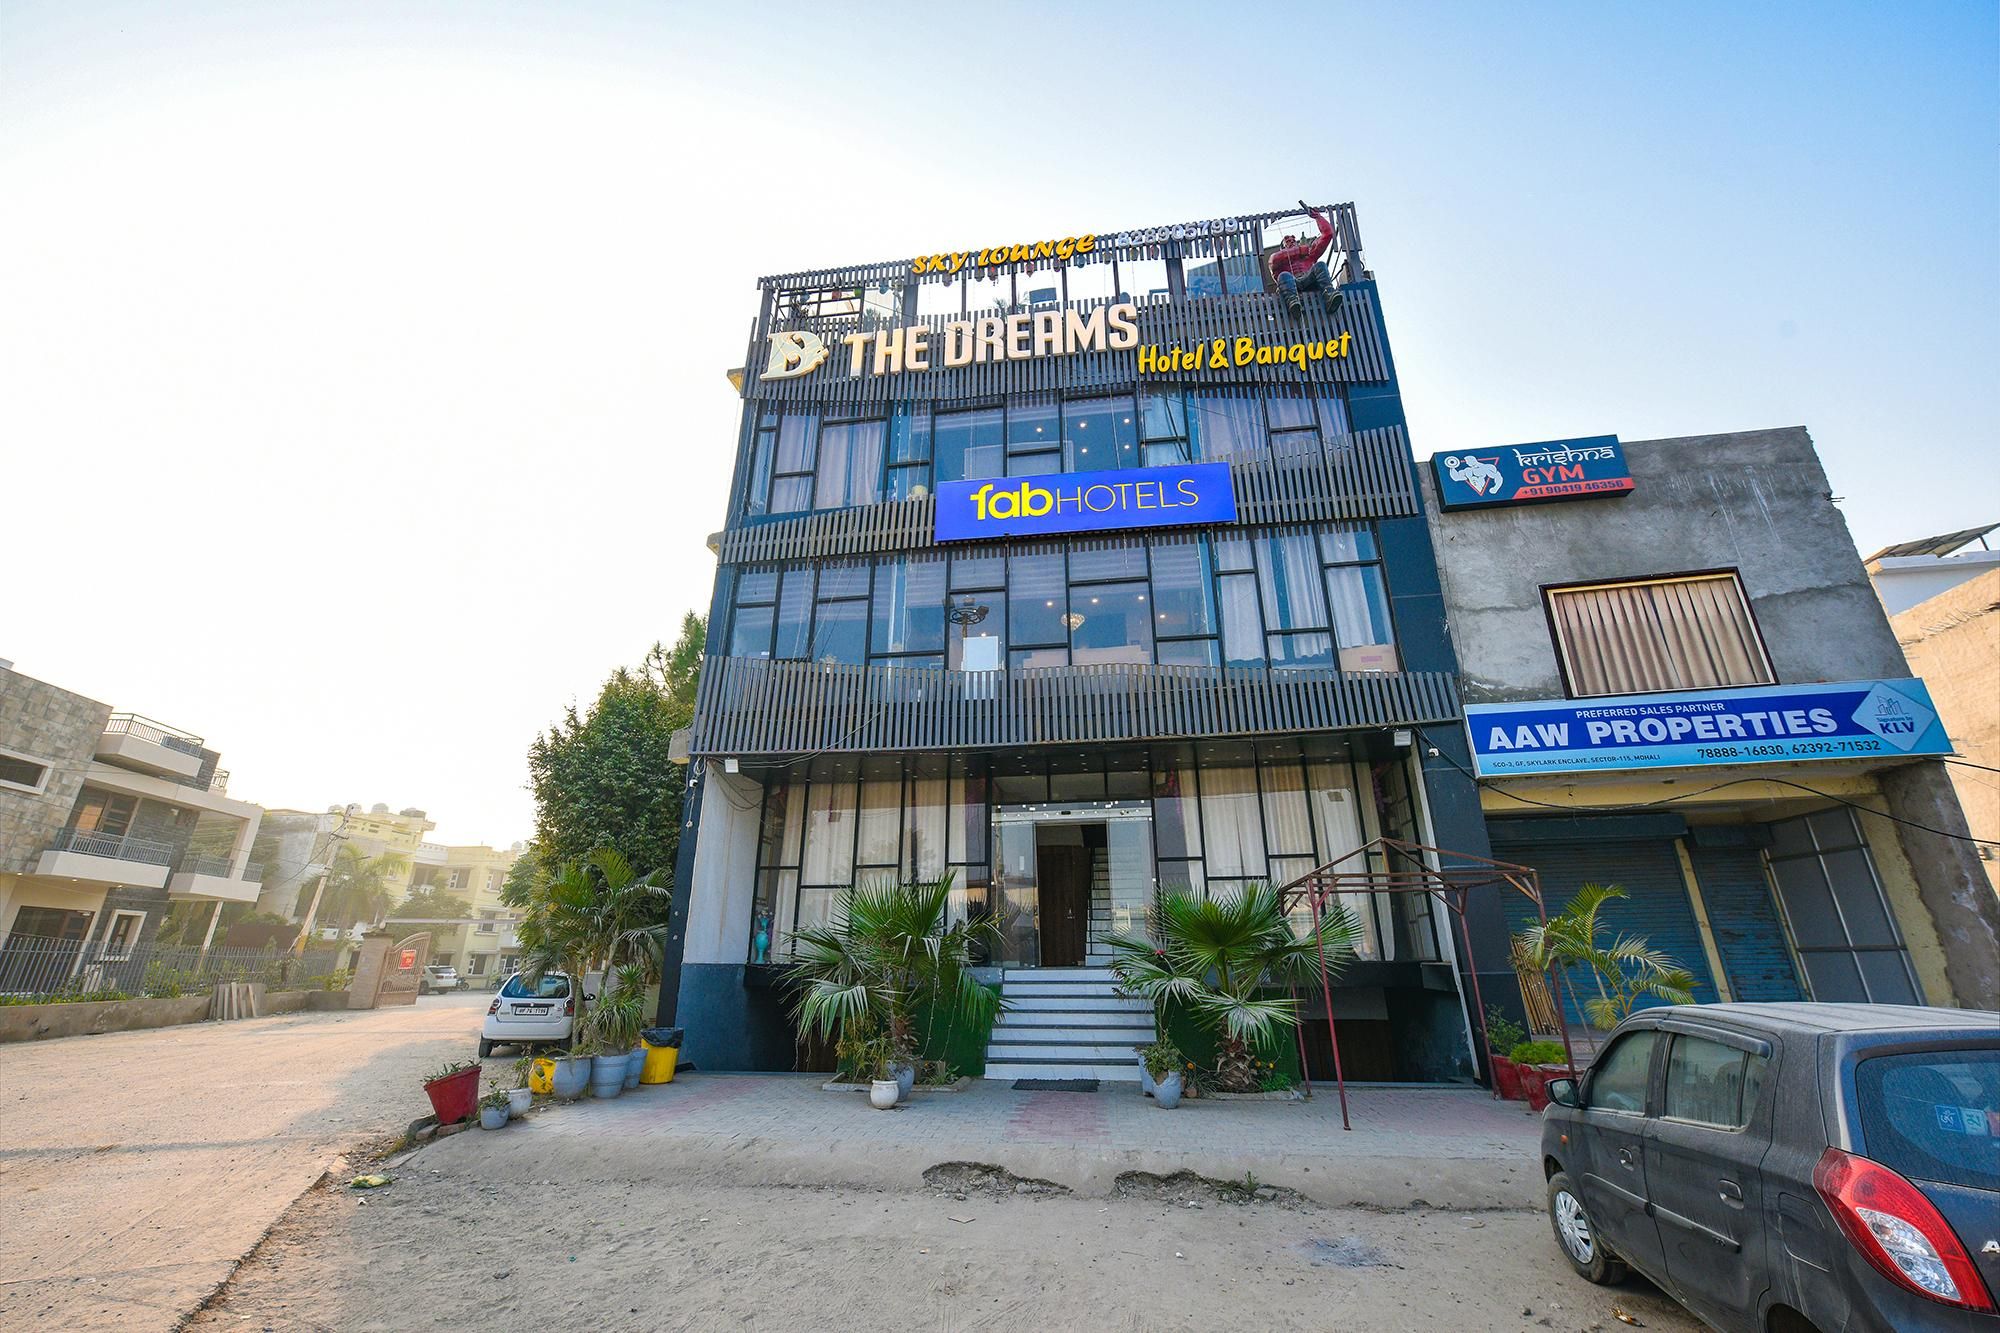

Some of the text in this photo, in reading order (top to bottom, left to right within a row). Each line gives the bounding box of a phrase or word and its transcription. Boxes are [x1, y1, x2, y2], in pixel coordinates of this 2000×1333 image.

[911, 233, 1095, 274] SKY LOUNGE
[843, 303, 1139, 379] THE DREAMS
[1138, 331, 1352, 374] Hotel & Banquet
[1512, 443, 1616, 467] krishna
[1522, 463, 1585, 485] GYM
[1576, 702, 1725, 719] PREFERRED SALES PARTNER
[1489, 708, 1838, 750] AAW PROPERTIES
[1879, 721, 1914, 734] KLV
[1697, 740, 1881, 759] 78888-16830, 62392-71532
